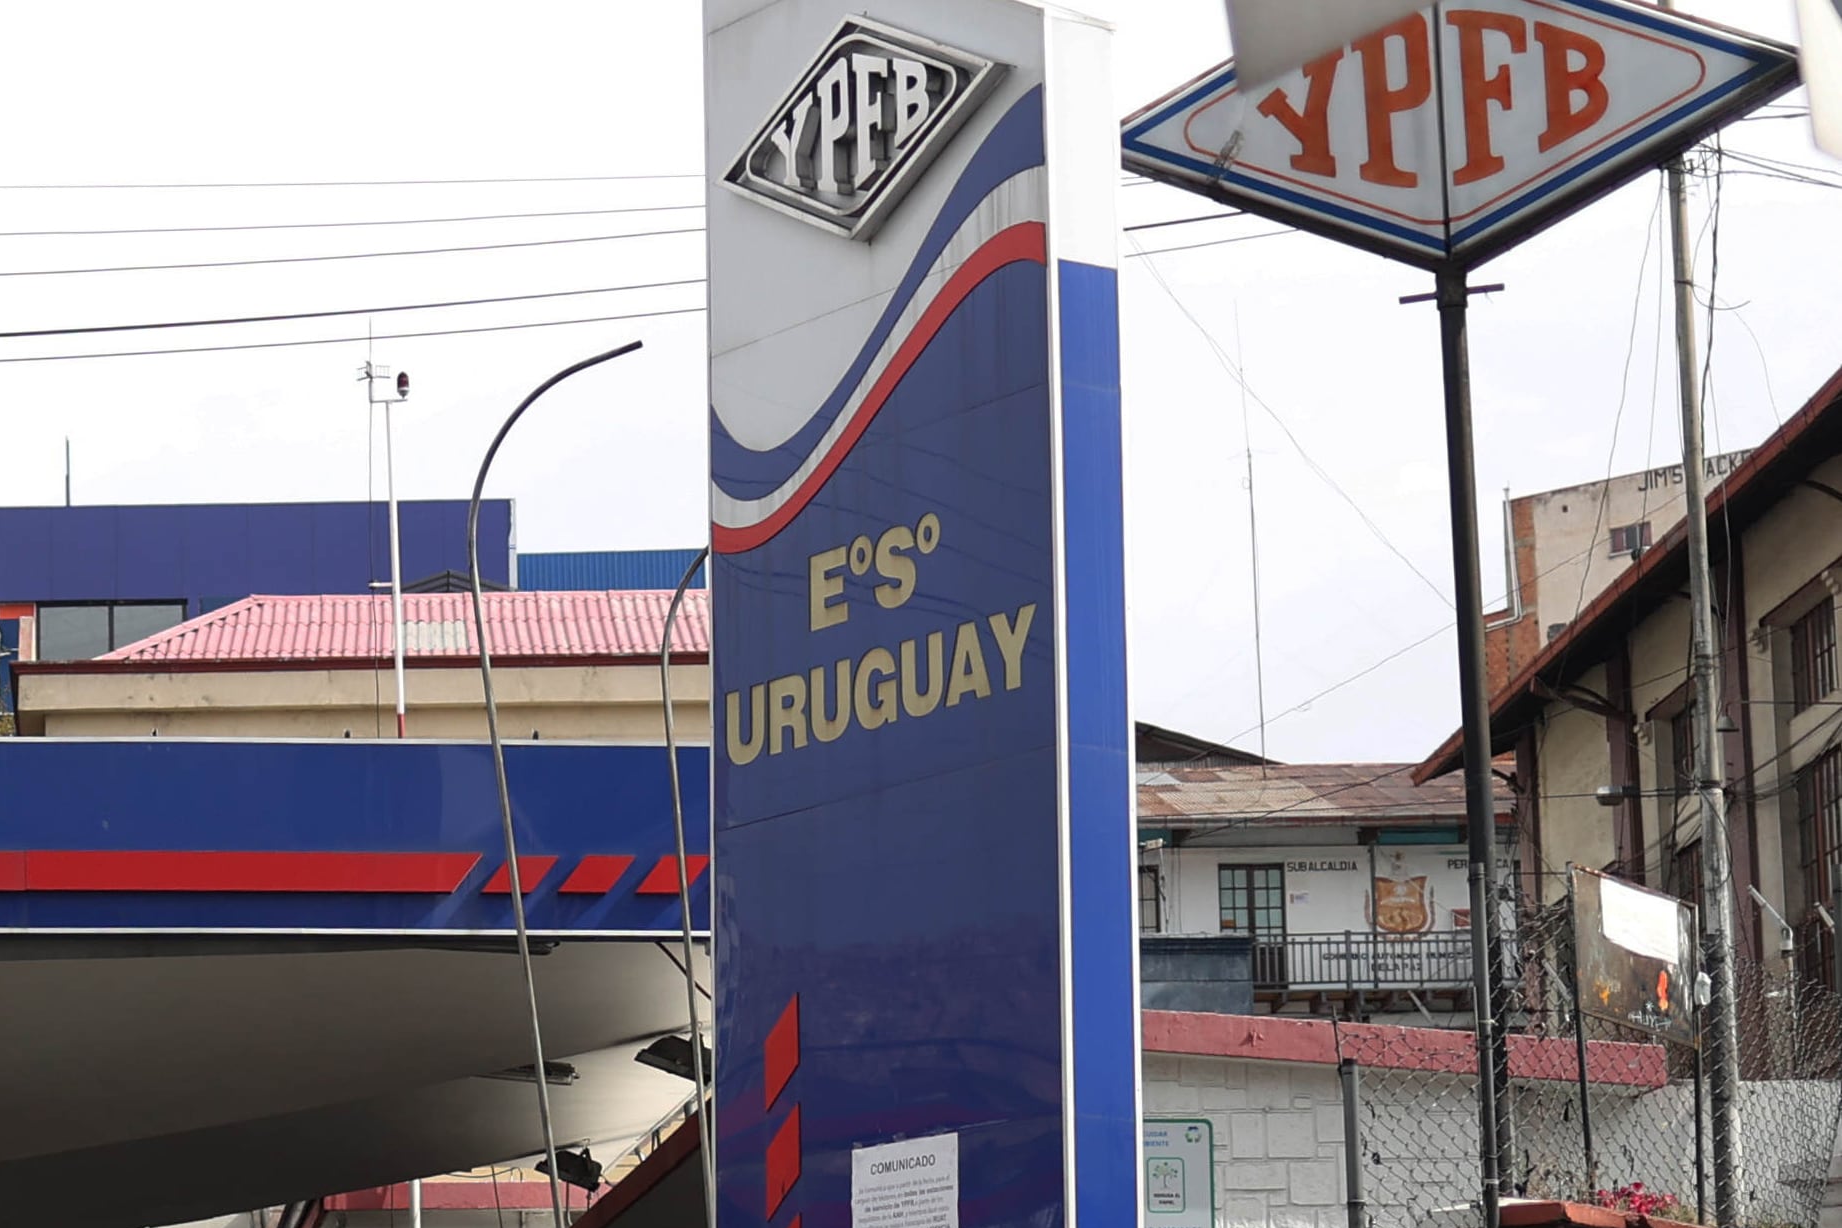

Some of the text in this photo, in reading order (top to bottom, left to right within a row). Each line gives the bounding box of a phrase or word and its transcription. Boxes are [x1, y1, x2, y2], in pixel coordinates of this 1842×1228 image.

[770, 52, 930, 193] YPFB
[1256, 9, 1609, 189] YPFB
[1638, 464, 1684, 492] JIM'S
[725, 603, 1037, 766] URUGUAY
[870, 1154, 936, 1176] COMUNICADO
